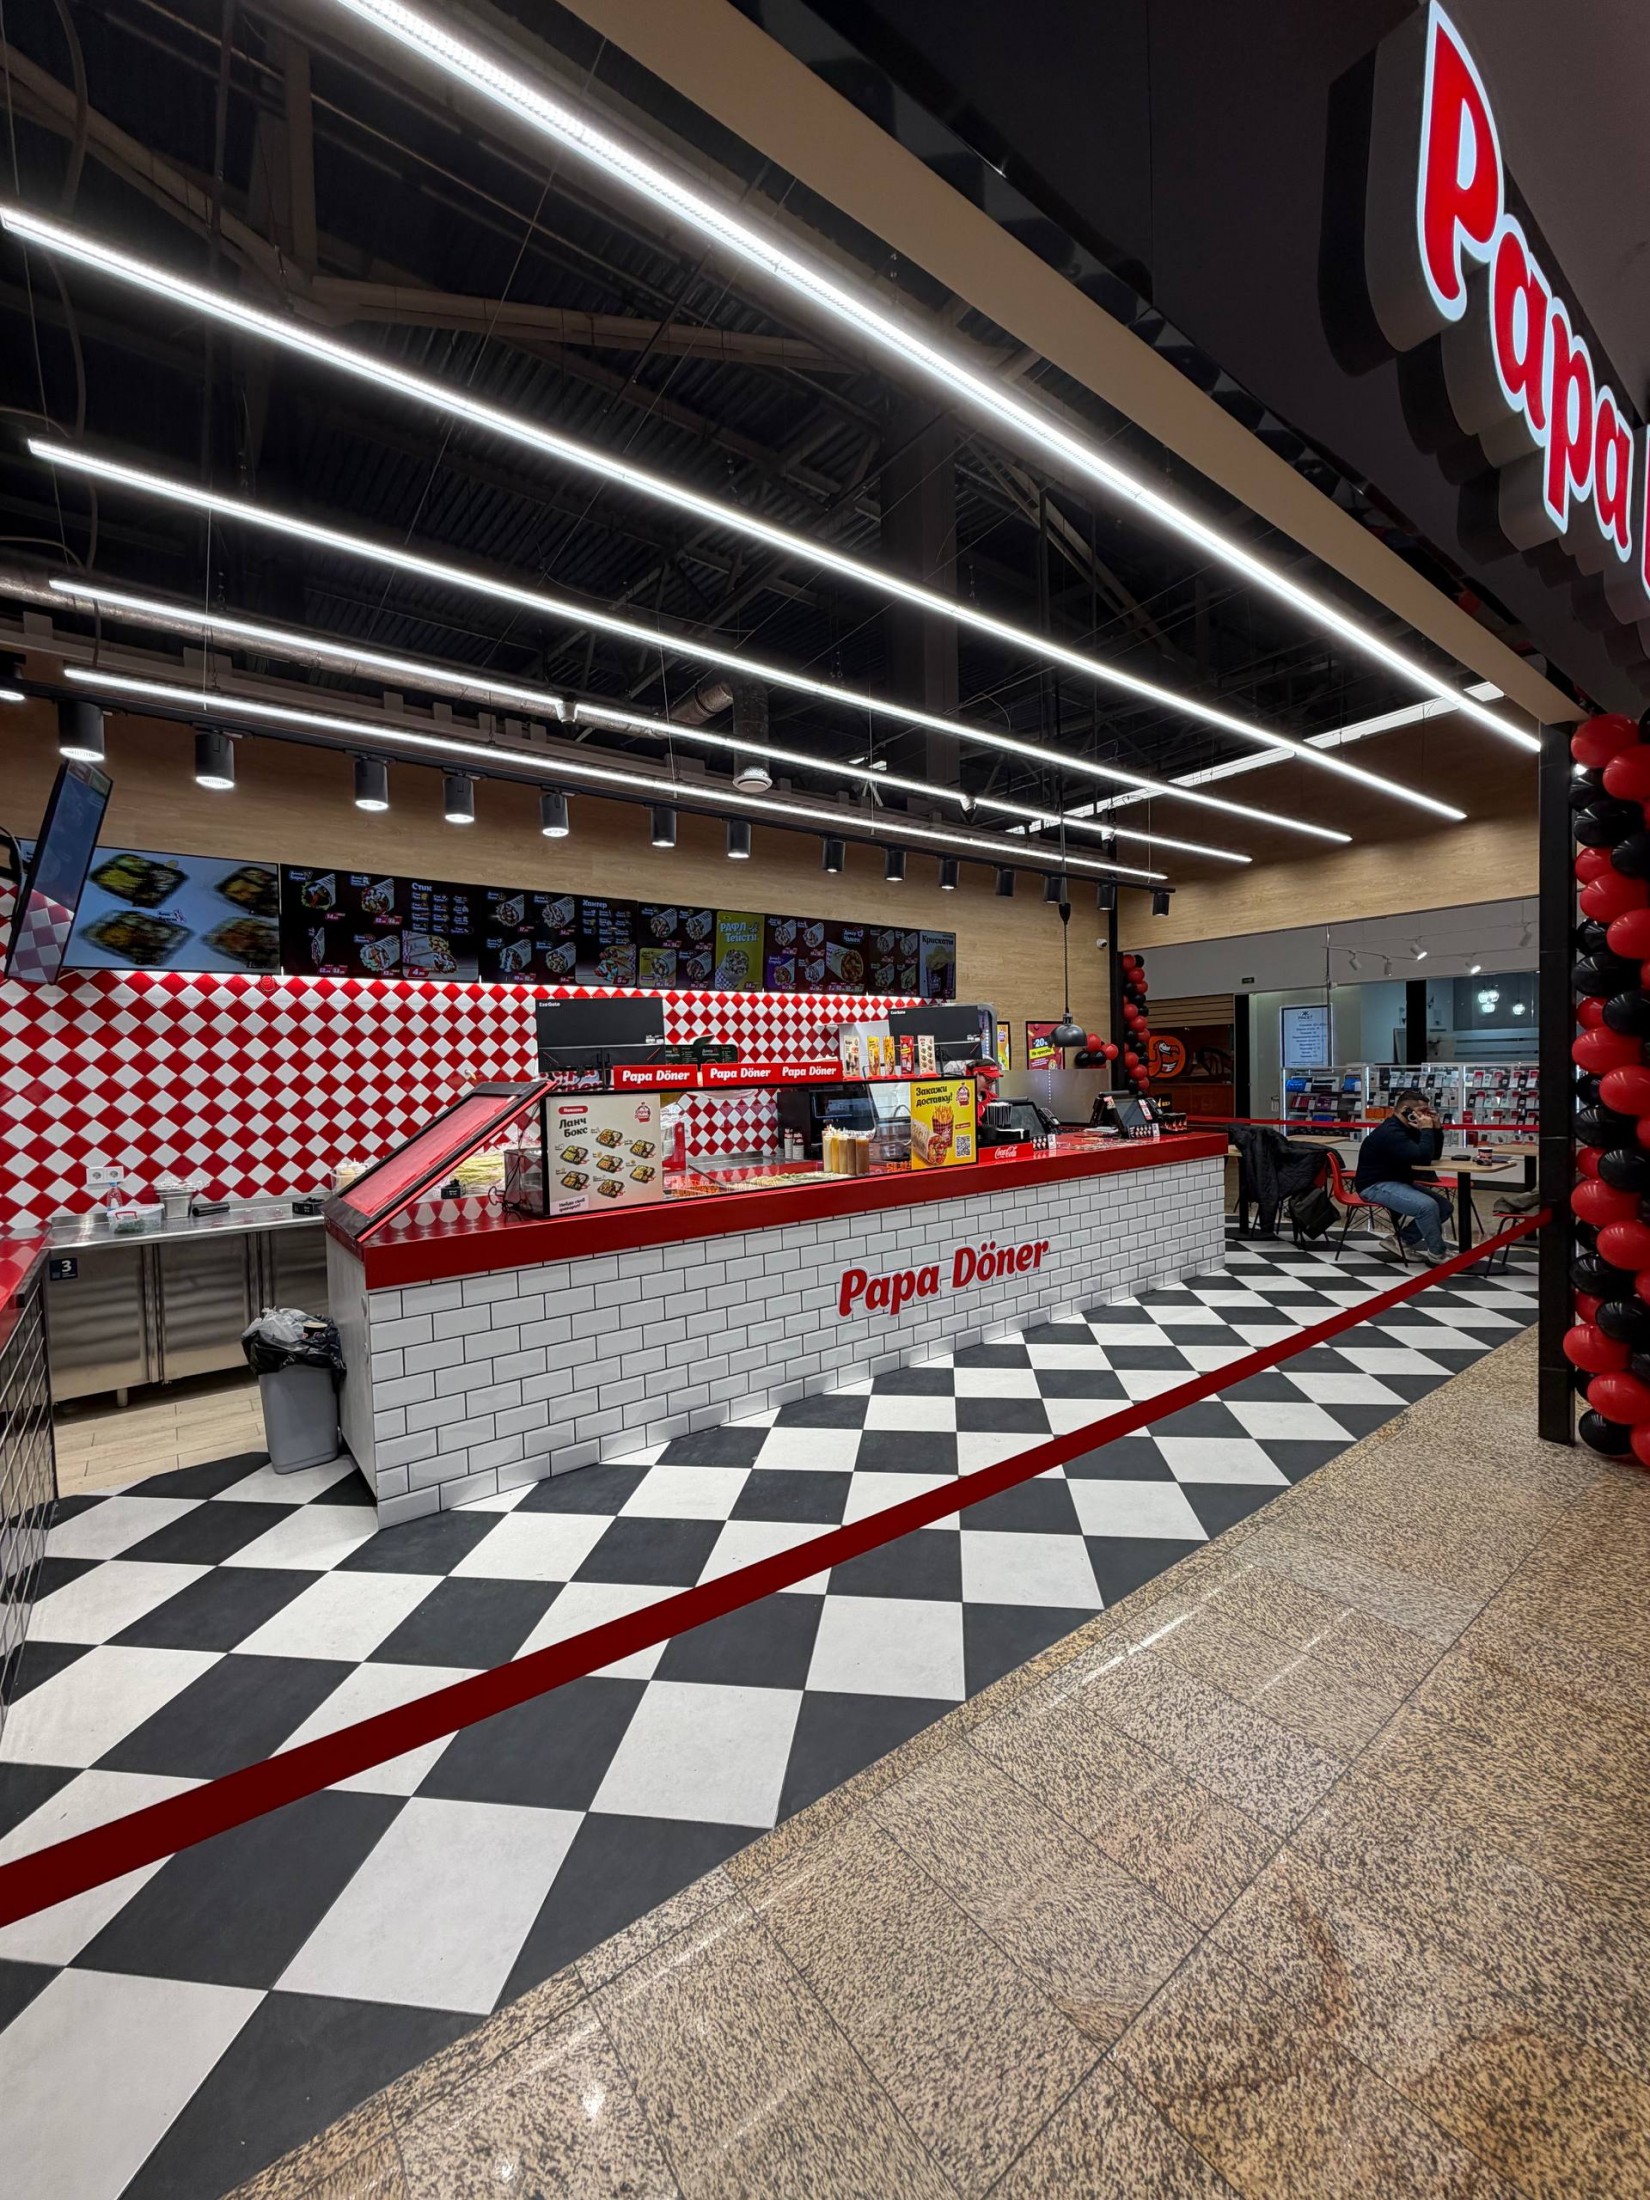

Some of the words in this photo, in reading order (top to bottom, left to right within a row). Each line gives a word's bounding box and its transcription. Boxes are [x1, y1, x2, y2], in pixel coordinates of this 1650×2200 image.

[1416, 0, 1634, 563] Papa
[411, 883, 433, 893] Стик
[720, 923, 746, 935] РАФЛ
[622, 1071, 652, 1084] Papa
[656, 1070, 690, 1081] Döner
[710, 1068, 737, 1080] Papa
[741, 1067, 771, 1078] Döner
[782, 1066, 806, 1078] Papa
[809, 1065, 837, 1076] Döner
[915, 1086, 947, 1097] Закажи
[916, 1093, 953, 1108] доставку!
[559, 1117, 586, 1129] Ланч
[564, 1127, 588, 1138] Бокс
[61, 1259, 73, 1273] 3
[840, 1265, 940, 1317] Papa
[952, 1238, 1050, 1290] Döner
